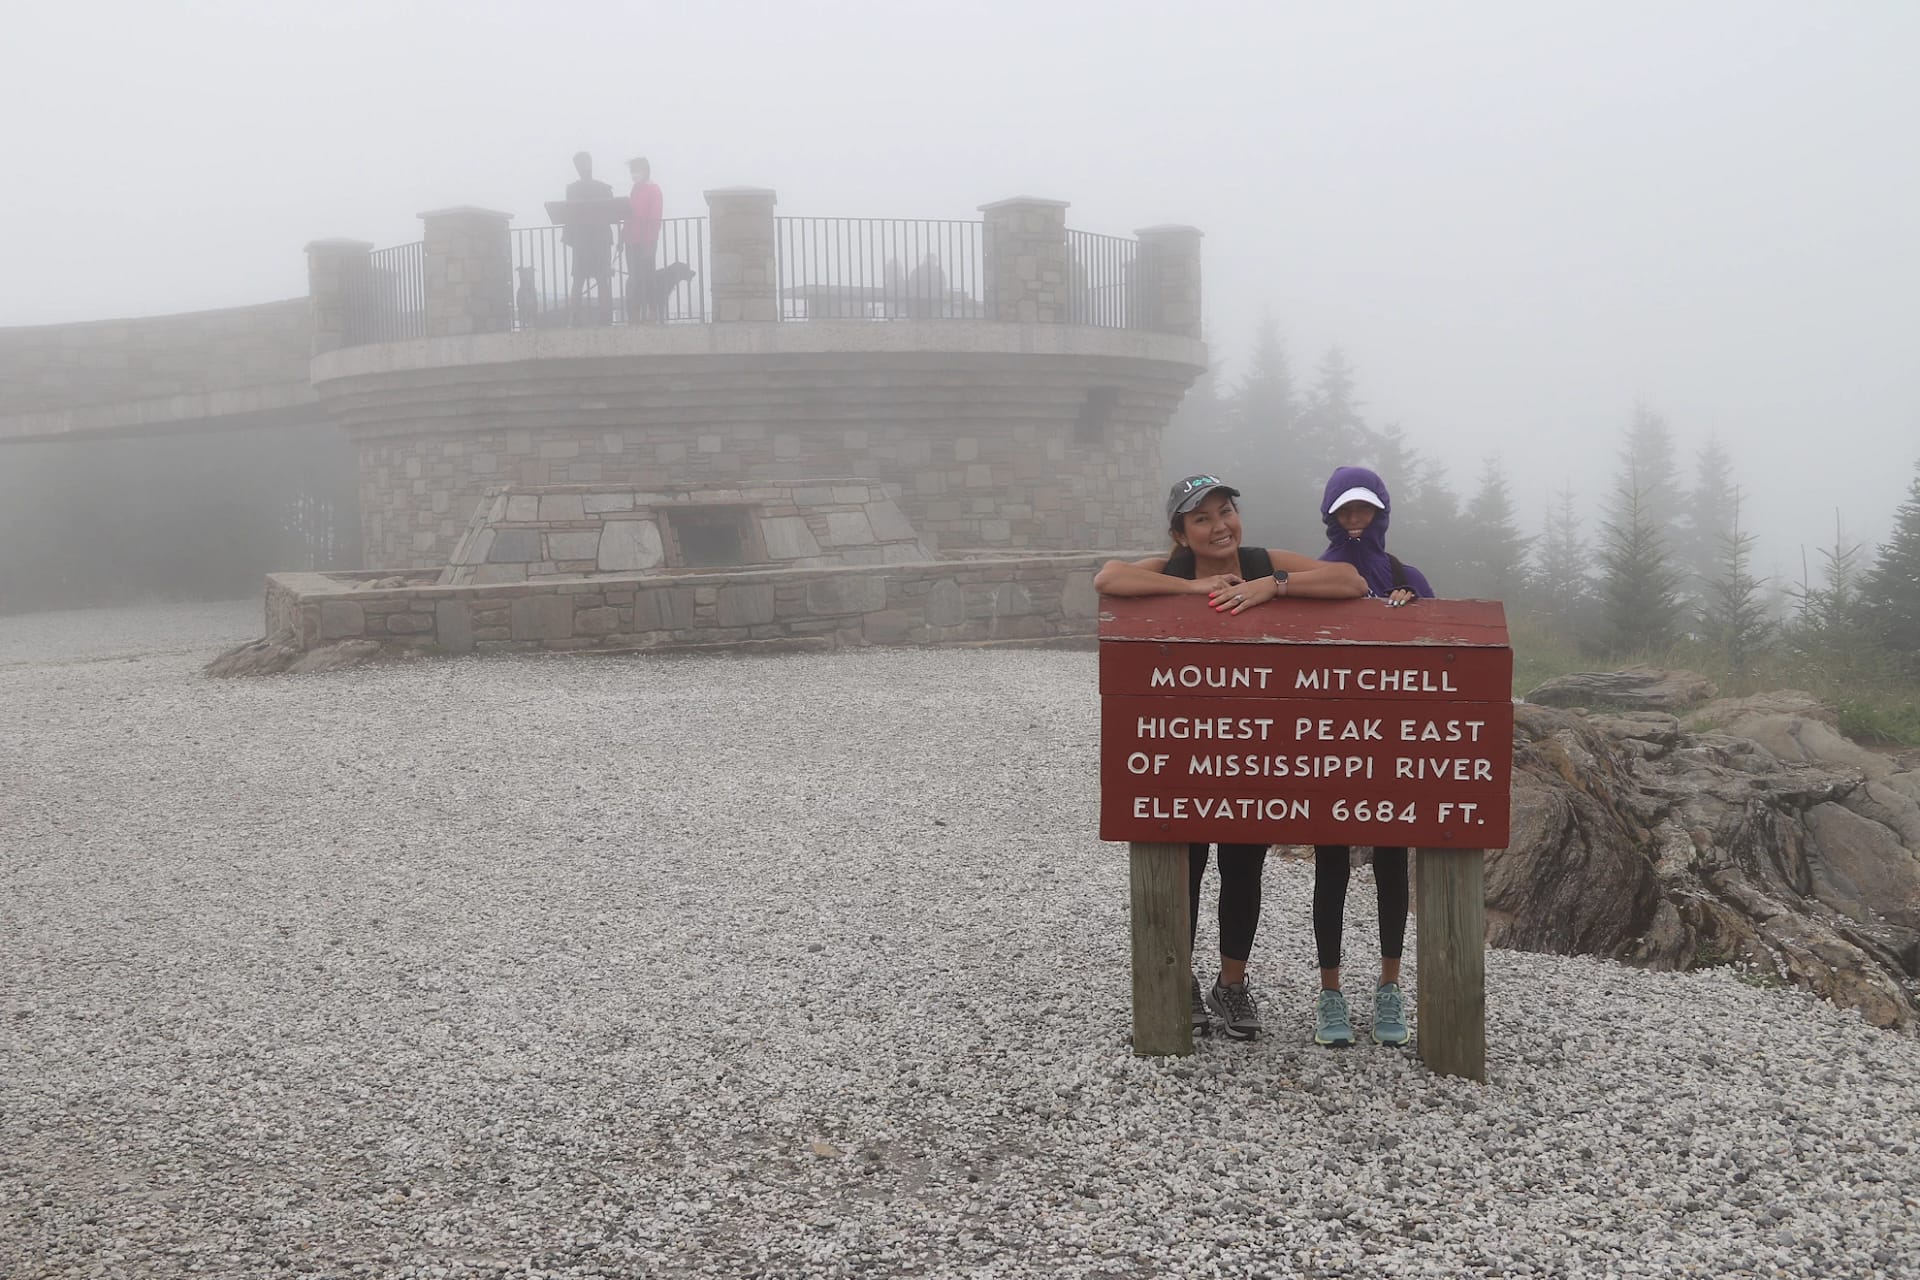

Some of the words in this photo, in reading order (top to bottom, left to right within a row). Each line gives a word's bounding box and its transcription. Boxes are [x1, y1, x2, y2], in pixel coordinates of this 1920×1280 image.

[1150, 666, 1273, 689] MOUNT
[1294, 668, 1458, 692] MITCHELL
[1137, 717, 1274, 741] HIGHEST
[1295, 718, 1383, 741] PEAK
[1400, 720, 1485, 742] EAST
[1127, 751, 1170, 776] OF
[1188, 754, 1373, 779] MISSISSIPPI
[1396, 757, 1493, 781] RIVER
[1133, 796, 1310, 821] ELEVATION
[1332, 799, 1417, 824] 6684
[1438, 802, 1485, 825] FT.
